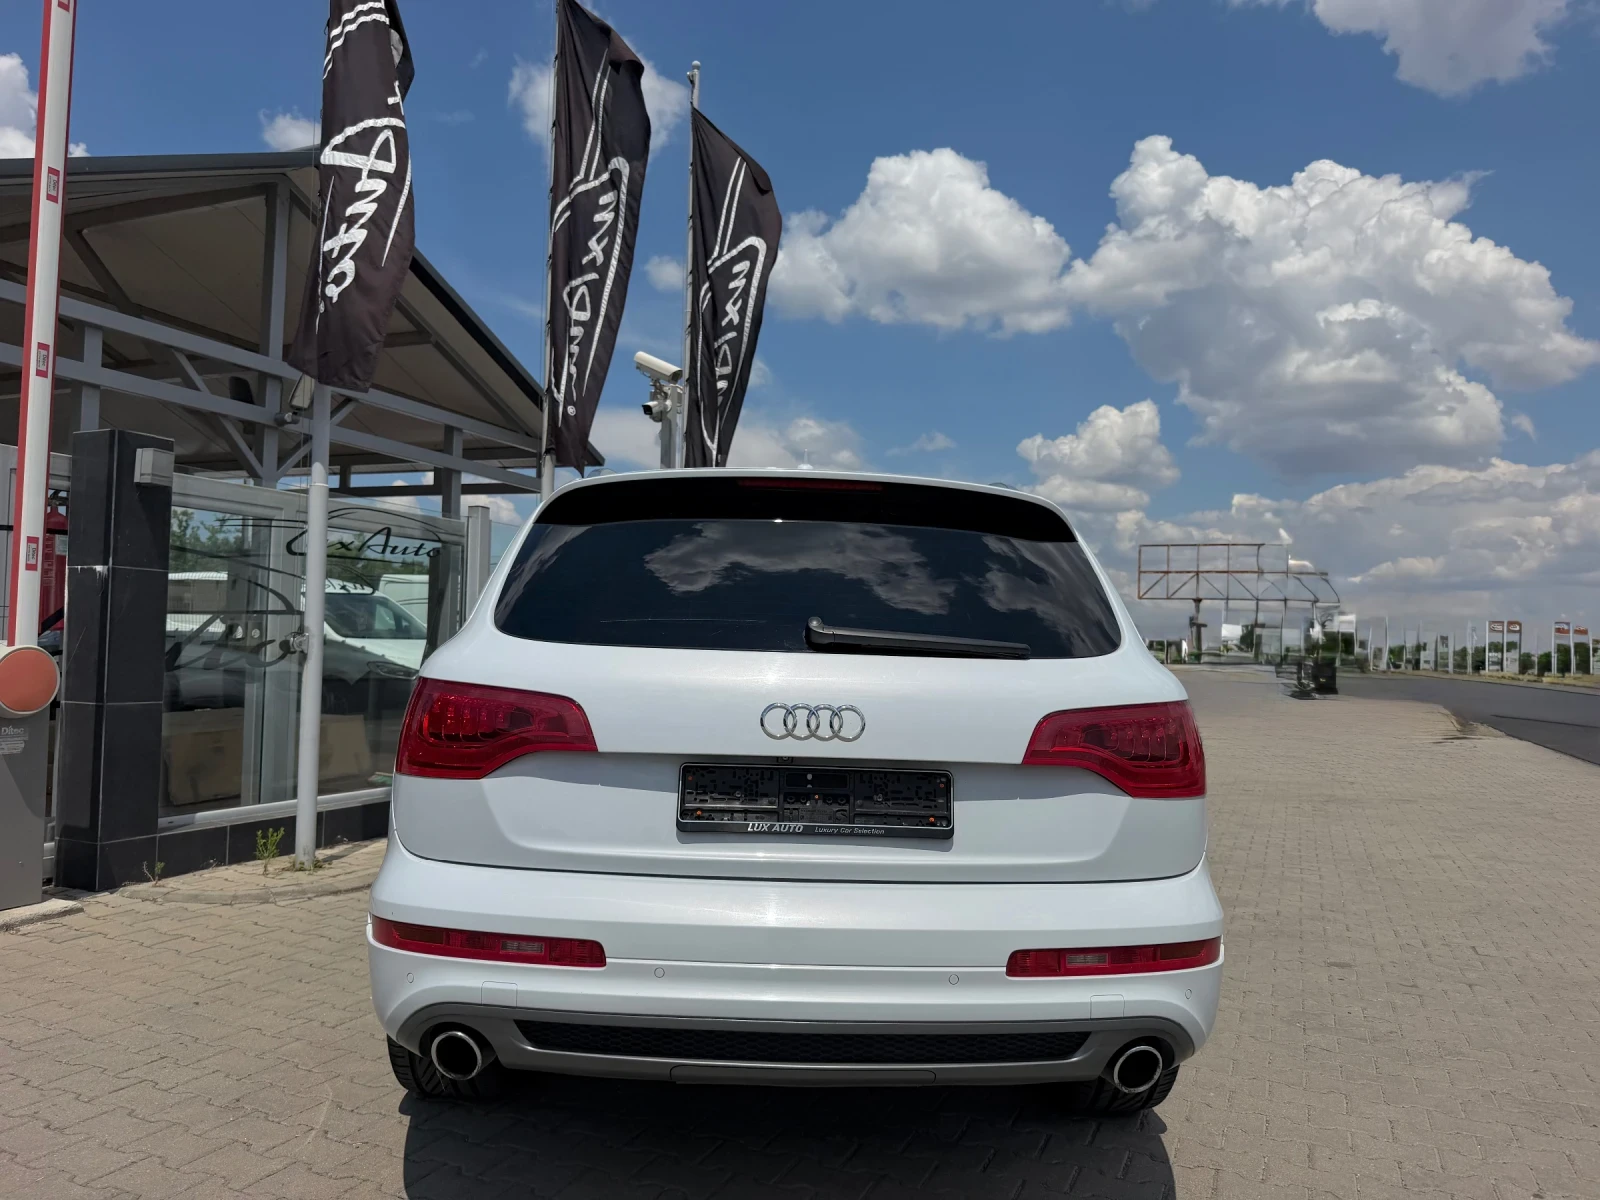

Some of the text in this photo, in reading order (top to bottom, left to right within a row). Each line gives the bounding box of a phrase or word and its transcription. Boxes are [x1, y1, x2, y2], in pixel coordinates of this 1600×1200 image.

[357, 526, 444, 558] Auto
[2, 725, 25, 735] Ditec
[747, 822, 804, 833] LUX AUTO
